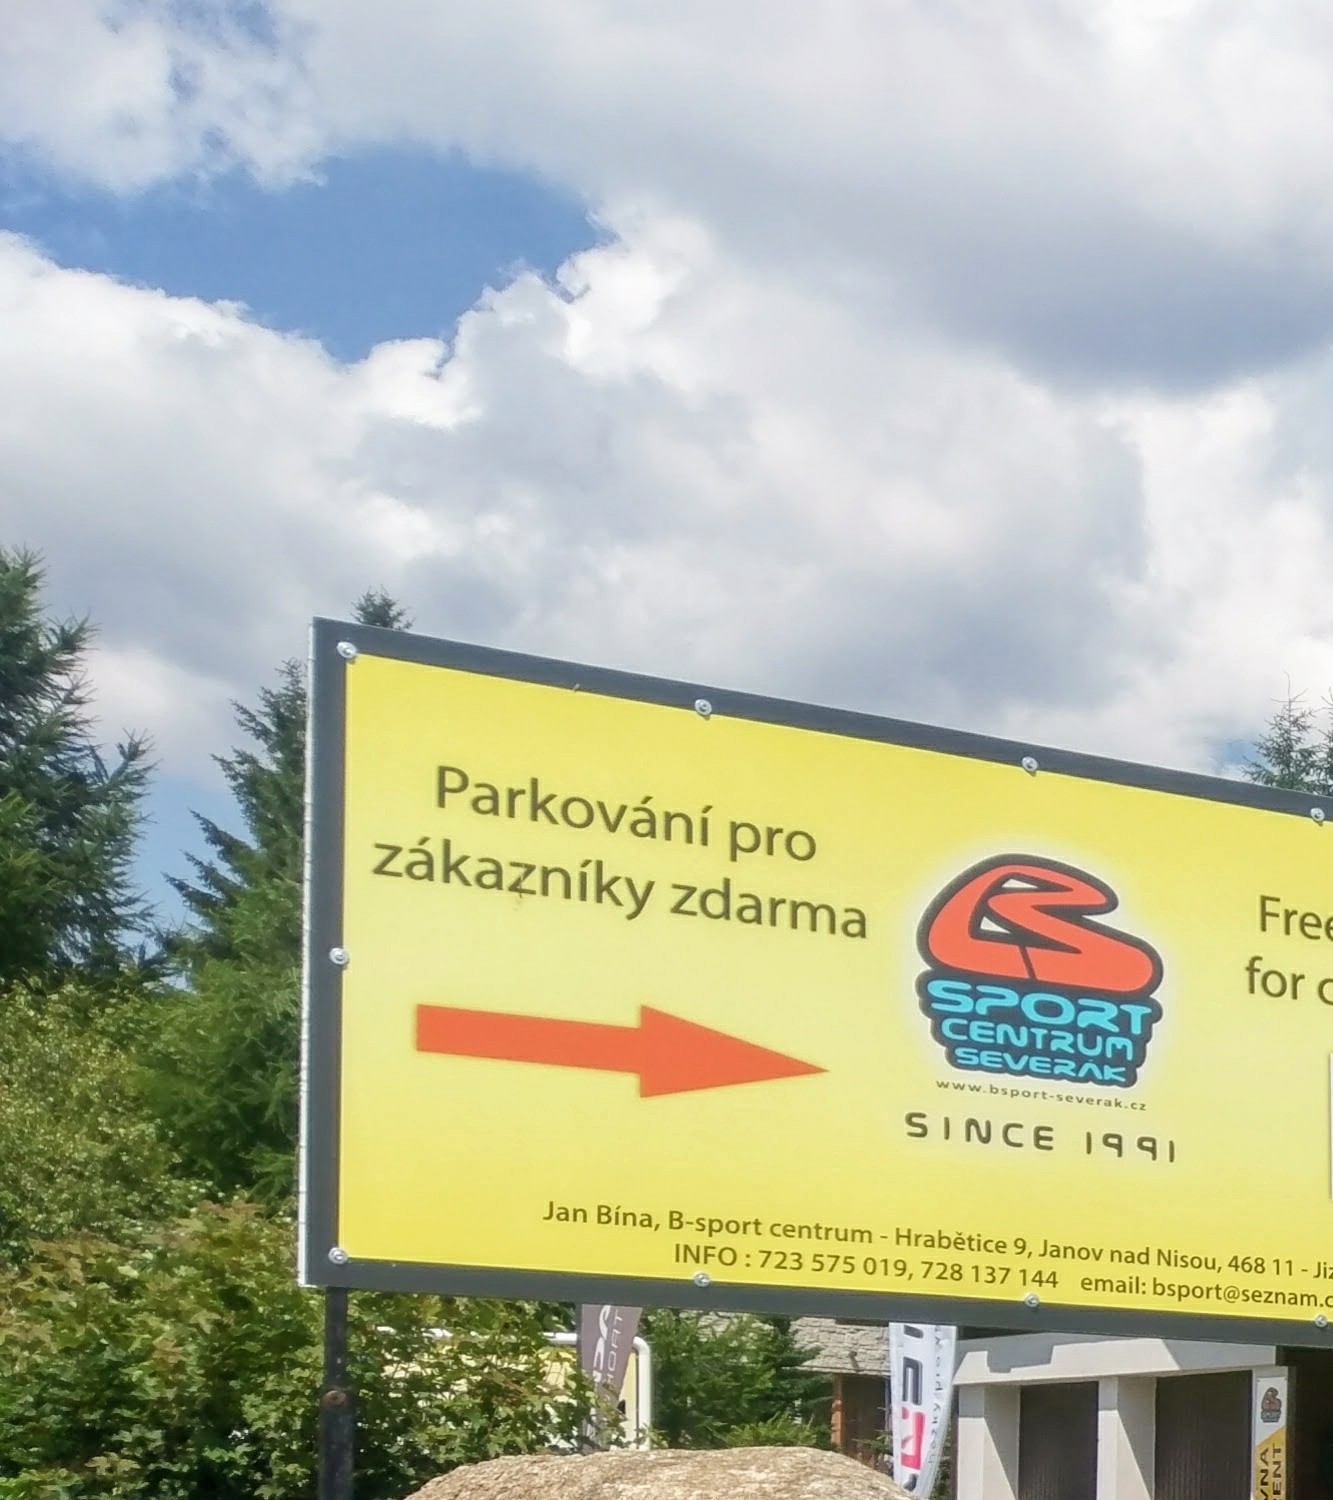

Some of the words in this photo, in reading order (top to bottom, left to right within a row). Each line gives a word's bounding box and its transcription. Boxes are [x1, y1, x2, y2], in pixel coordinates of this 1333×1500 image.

[436, 765, 714, 847] Parkování
[729, 818, 817, 861] pro
[372, 836, 655, 920] zákazníky
[670, 877, 867, 939] zdarma
[1245, 955, 1305, 1000] for
[927, 979, 1152, 1035] SPORT
[941, 1017, 1133, 1061] CENTRUM
[935, 1079, 1147, 1111] www.bsport-severak.cz
[904, 1111, 1054, 1151] SINCE
[1085, 1131, 1175, 1163] 1991
[543, 1201, 588, 1224] Jan
[597, 1204, 661, 1232] Bína,
[668, 1210, 762, 1239] B-sport
[769, 1219, 873, 1244] centrum
[894, 1227, 1007, 1254] Hrabětice
[1013, 1237, 1033, 1260] 9,
[1038, 1239, 1103, 1262] Janov
[1109, 1246, 1150, 1266] nad
[1156, 1249, 1223, 1273] Nisou,
[1227, 1255, 1266, 1274] 468
[1271, 1258, 1294, 1276] 11
[674, 1243, 738, 1267] INFO
[758, 1249, 803, 1271] 723
[811, 1253, 856, 1275] 575
[863, 1256, 913, 1281] 019,
[920, 1260, 963, 1281] 728
[971, 1264, 1010, 1286] 137
[1018, 1268, 1059, 1289] 144
[1080, 1274, 1146, 1296] email:
